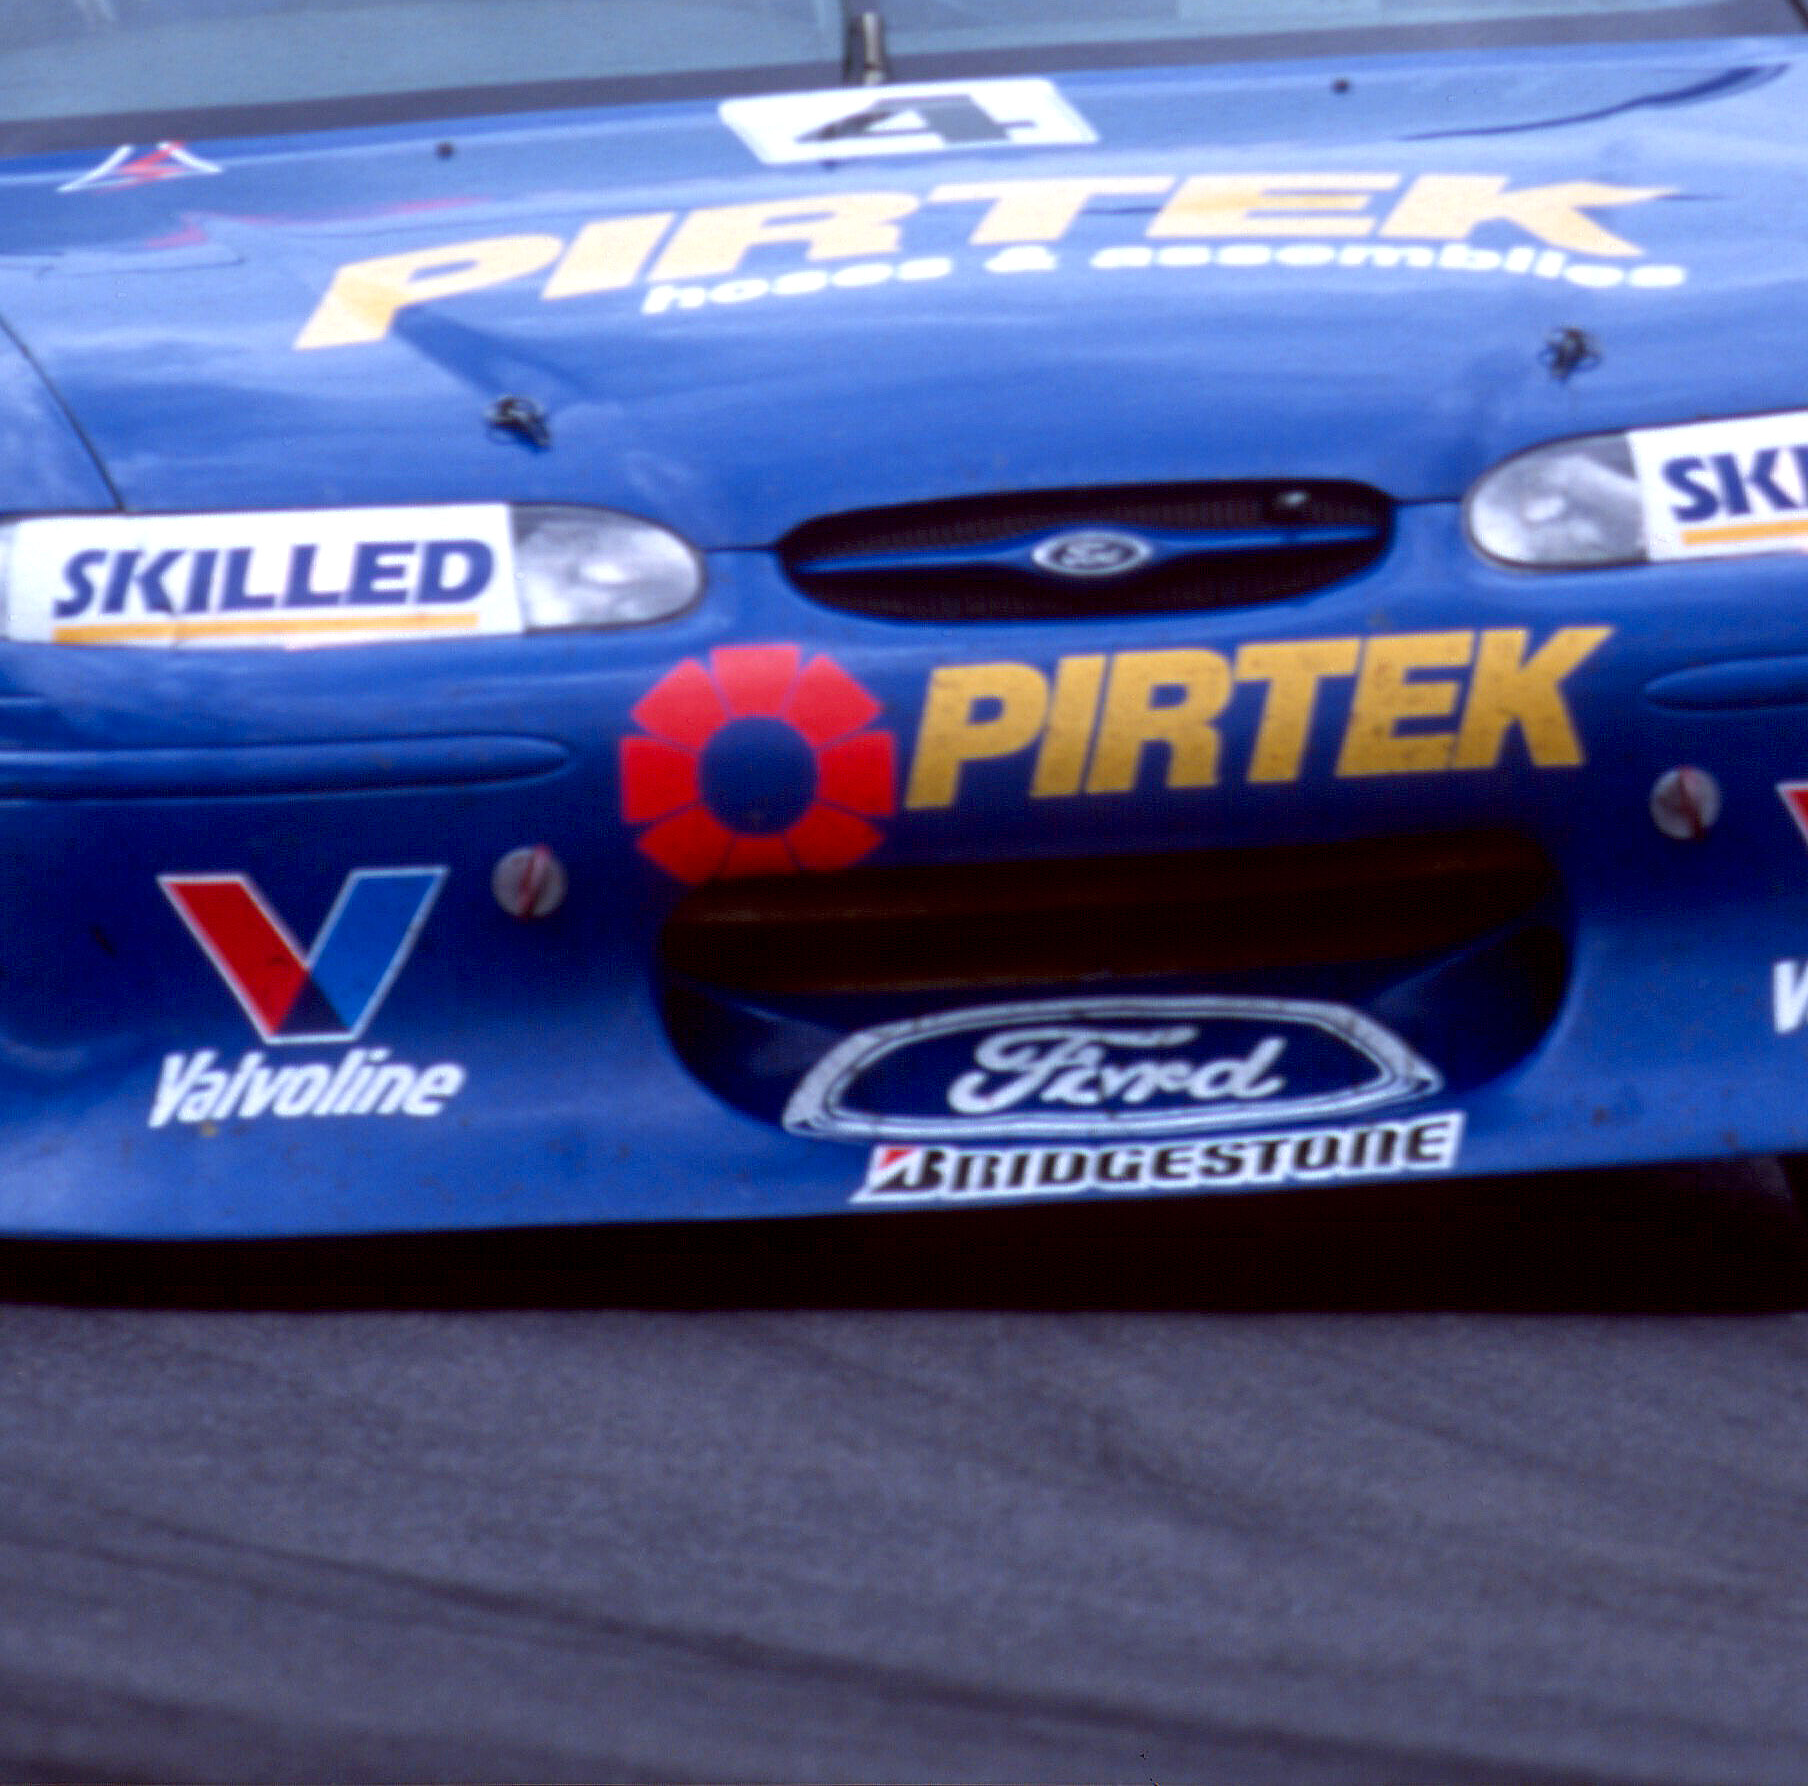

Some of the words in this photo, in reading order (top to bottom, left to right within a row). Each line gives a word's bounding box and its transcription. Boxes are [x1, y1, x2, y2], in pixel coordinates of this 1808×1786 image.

[795, 94, 1040, 144] 4
[294, 173, 1694, 350] PIRTEK
[53, 539, 496, 617] SKILLED
[903, 626, 1614, 811] PIRTEK
[148, 1048, 468, 1128] Valvoline
[949, 1024, 1287, 1116] Ford
[860, 1116, 1460, 1198] BRIDGESTONE
